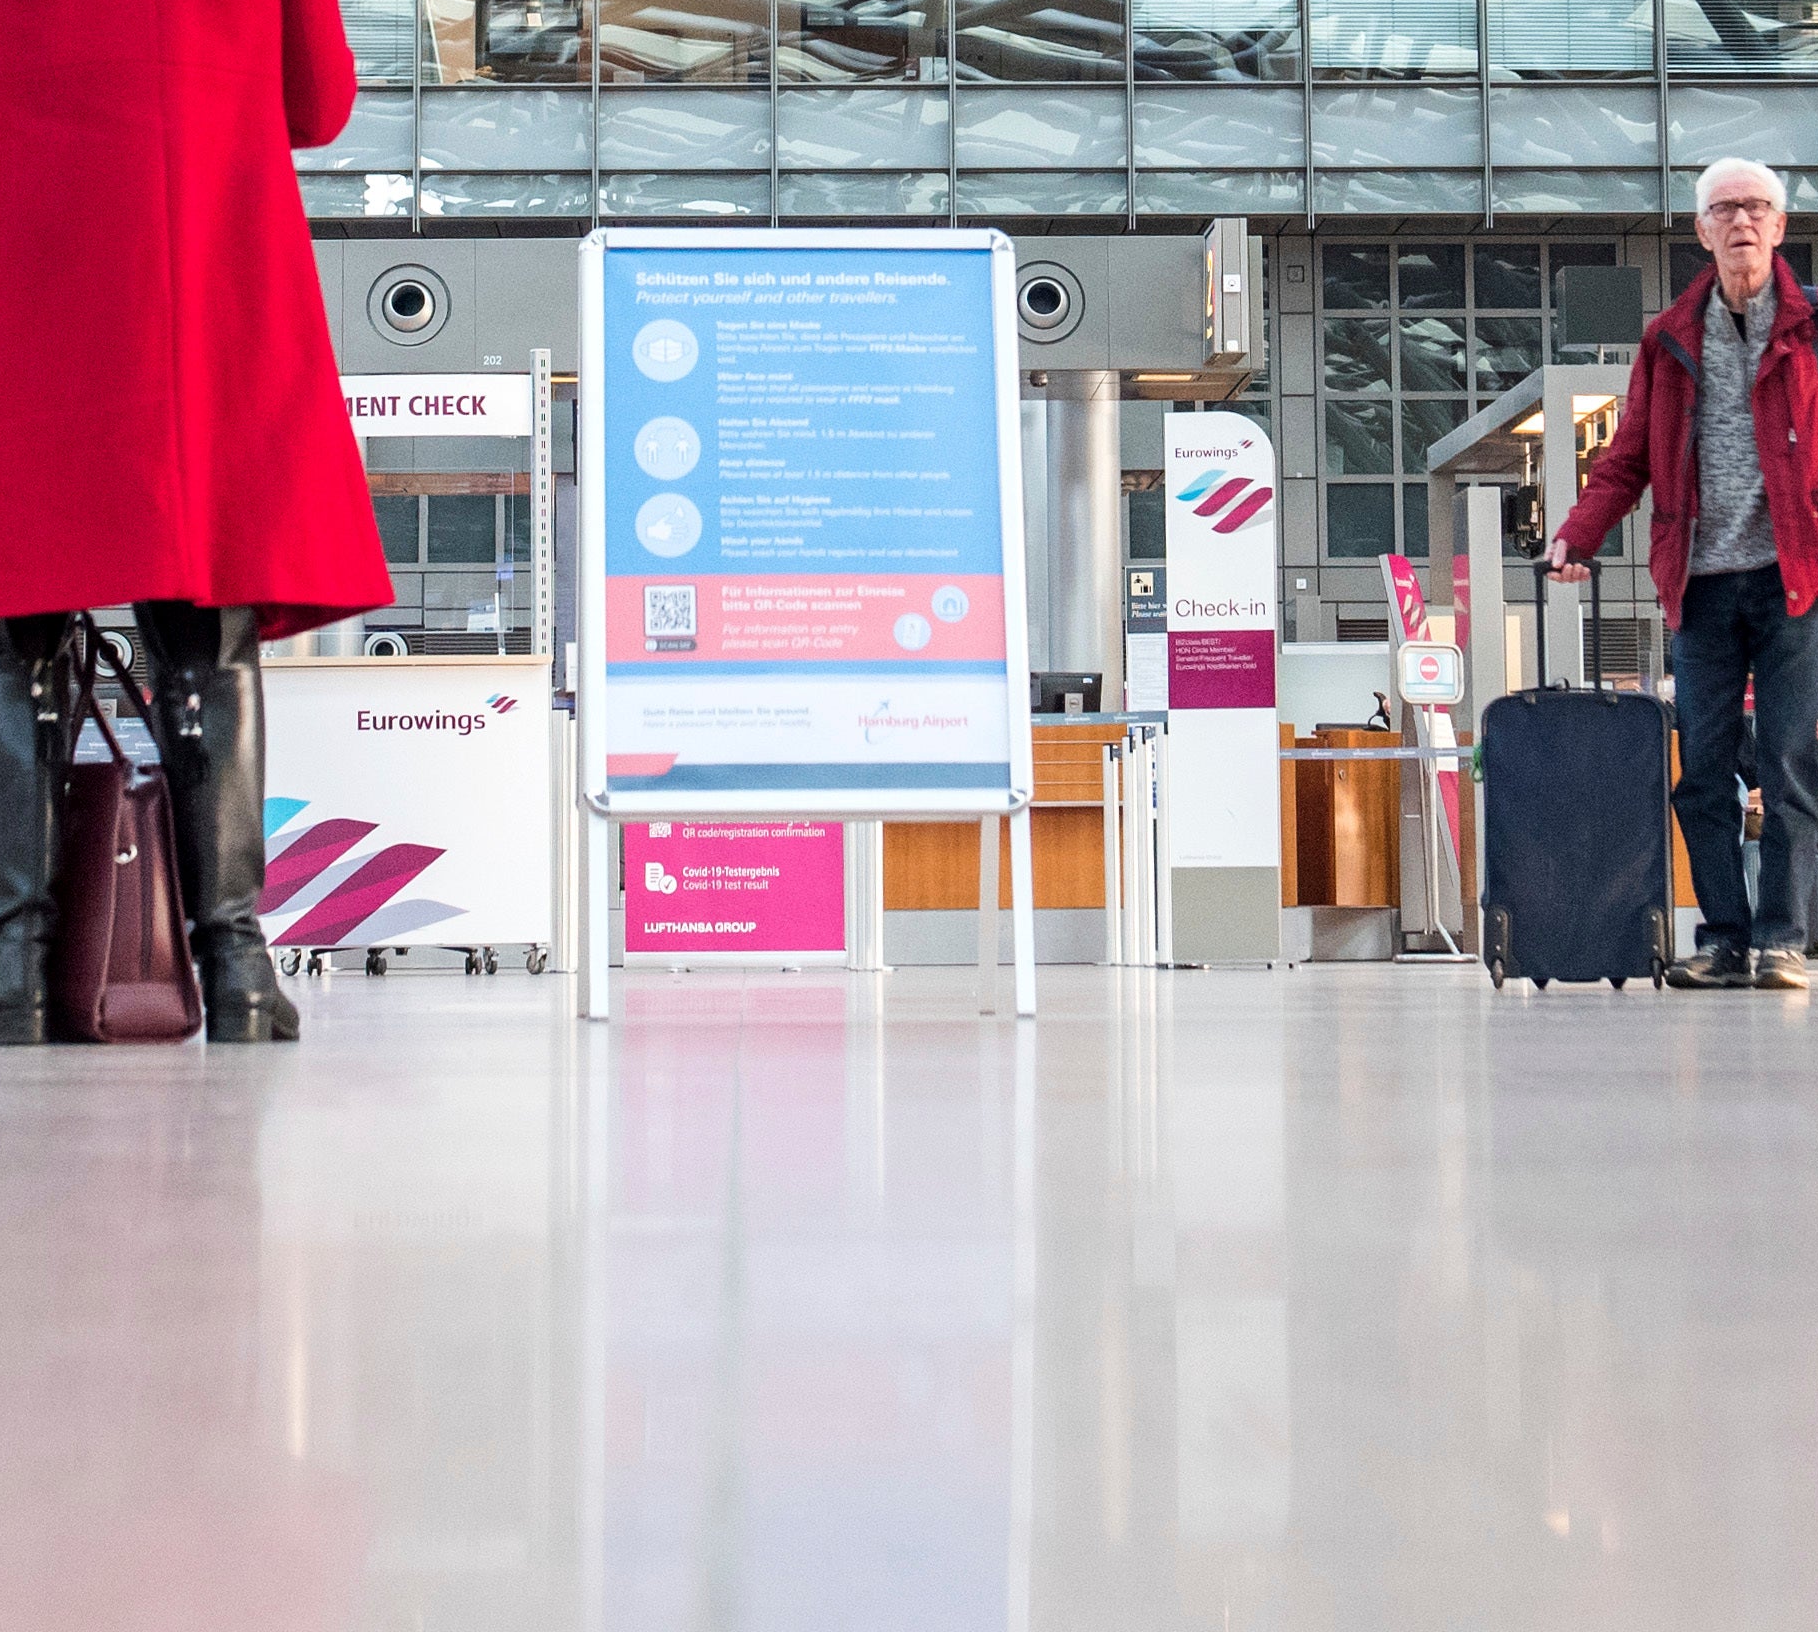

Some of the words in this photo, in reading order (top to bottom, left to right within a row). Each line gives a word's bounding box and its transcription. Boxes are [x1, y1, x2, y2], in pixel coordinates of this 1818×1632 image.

[635, 272, 709, 286] Schützen
[714, 273, 739, 286] Sie
[744, 273, 775, 286] sich
[781, 273, 811, 286] und
[815, 273, 870, 286] andere
[875, 273, 951, 286] Reisende.
[635, 291, 689, 304] Protect
[693, 291, 751, 306] yourself
[754, 291, 782, 304] and
[787, 291, 825, 304] other
[831, 291, 898, 305] travellers.
[484, 355, 502, 365] 202
[409, 396, 486, 416] CHECK
[1175, 448, 1238, 459] Eurowings
[1175, 599, 1265, 617] Check-in
[358, 710, 485, 735] Eurowings
[858, 716, 919, 729] Hamburg
[922, 716, 968, 729] Airport
[683, 828, 695, 839] QR
[697, 828, 769, 840] code/registration
[772, 827, 825, 837] confirmation
[683, 866, 779, 879] Covid-19-Testergebnis
[683, 880, 722, 890] Covid-19
[724, 881, 741, 890] test
[744, 880, 768, 889] result
[645, 922, 713, 933] LUFTHANSA
[715, 922, 756, 932] GROUP
